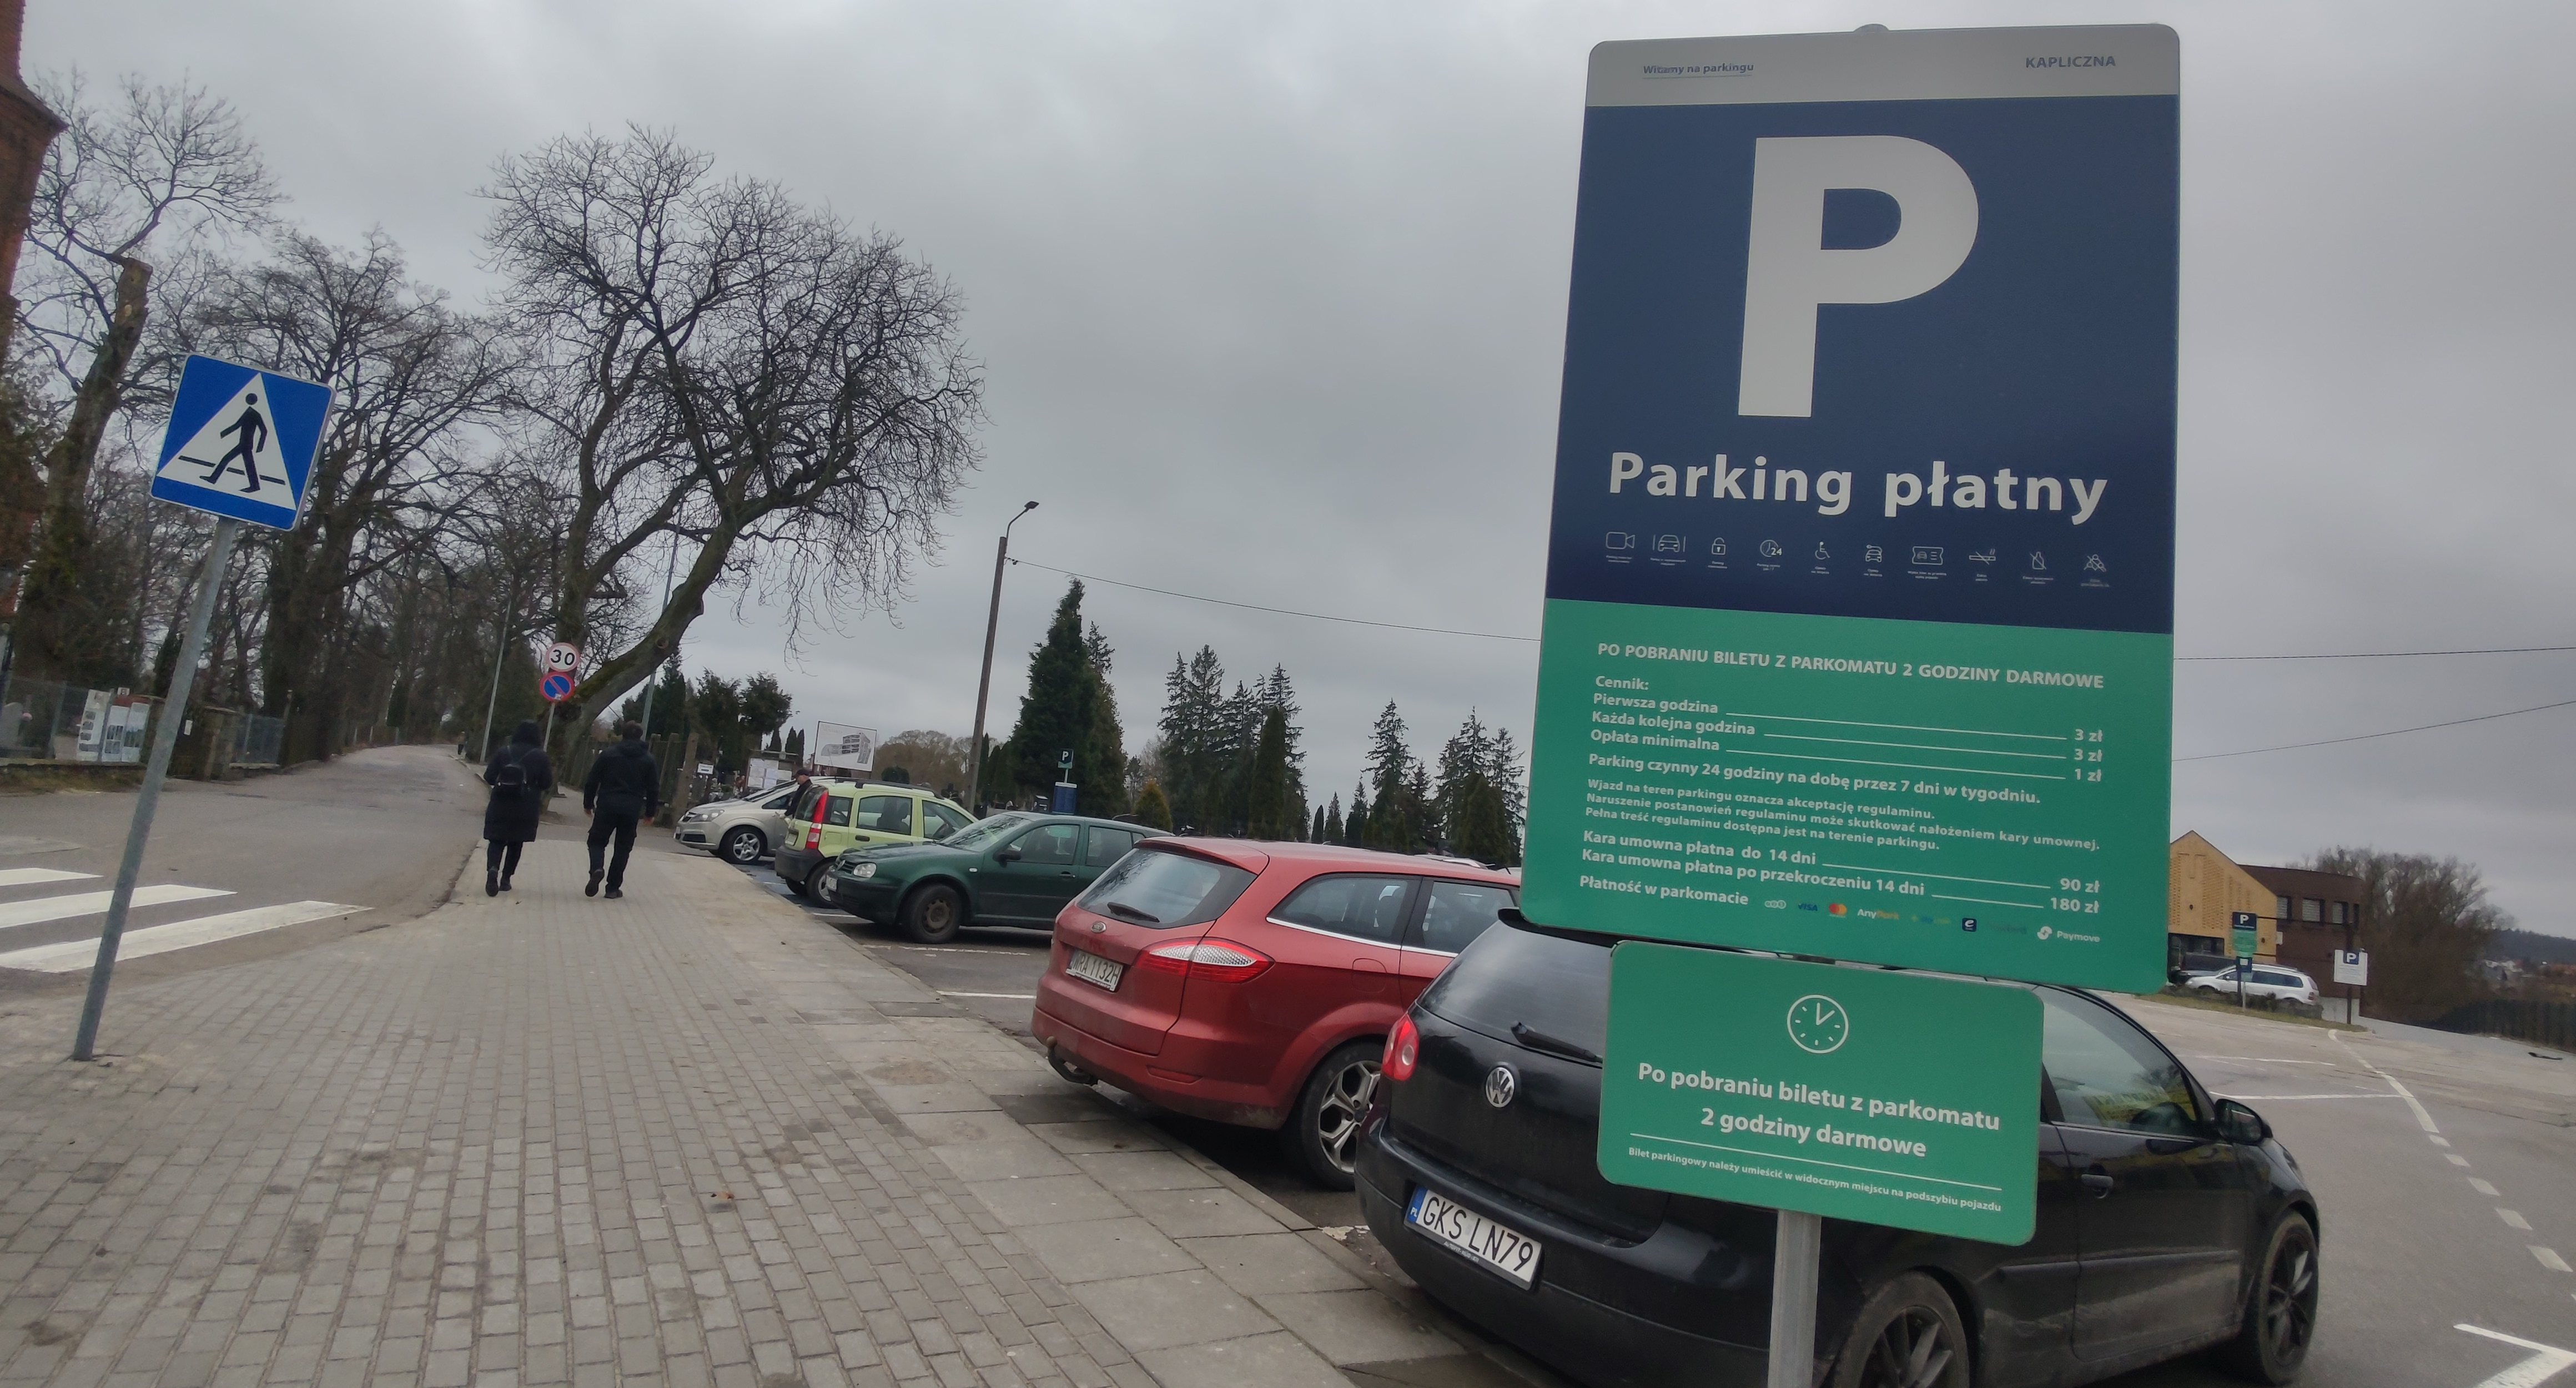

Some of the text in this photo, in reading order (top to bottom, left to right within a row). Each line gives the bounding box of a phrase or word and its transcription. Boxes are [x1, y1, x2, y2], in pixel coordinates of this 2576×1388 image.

[1643, 65, 1684, 74] Witamy
[1703, 63, 1754, 74] parkingu
[2026, 56, 2116, 68] KAPLICZNA
[1738, 135, 1979, 417] P
[1608, 452, 2108, 525] Parking płatny
[1771, 547, 1782, 556] 24
[550, 649, 575, 665] 30
[1598, 643, 2104, 688] PO POBRANIU BILETU Z PARKOMATU 2 GODZINY DARMOWE
[1596, 675, 1649, 690] Cennik:
[1593, 693, 1718, 713] Pierwsza godzina
[1592, 711, 1755, 735] Każda kolejna godzina
[1591, 729, 1719, 750] Opłata minimalna
[2074, 729, 2103, 742] 3 zł
[1062, 751, 1069, 761] P
[2074, 749, 2102, 762] 3 zł
[1589, 754, 2040, 803] Parking czynny 24 godziny na dobę przez 7 dni w tygodniu.
[2075, 769, 2102, 782] 1 zł
[1588, 779, 1623, 791] Wjazd
[1643, 785, 1674, 795] teren
[1677, 788, 1732, 802] parkingu
[1735, 795, 1783, 805] oznacza
[1787, 797, 1854, 814] akceptację
[1858, 805, 1935, 819] regulaminu.
[1586, 807, 1617, 819] Pełna
[1621, 811, 1649, 821] treść
[1652, 816, 1720, 828] regulaminu
[1723, 820, 1780, 835] dostępna
[1783, 826, 1807, 837] jest
[1828, 831, 1874, 843] terenie
[1877, 836, 1939, 851] parkingu.
[1587, 793, 2100, 851] Naruszenie postanowień regulaminu może skutkować nałożeniem kary umownej.
[1583, 830, 1815, 865] Kara umowna płatna do 14 dni
[1582, 849, 1924, 895] Kara umowna płatna po przekroczeniu 14 dni
[1580, 875, 1641, 893] Płatność
[1644, 885, 1657, 895] w
[1661, 886, 1748, 905] parkomacie
[2060, 878, 2100, 893] 90 zł
[1798, 903, 1818, 912] VISA
[2051, 897, 2099, 913] 180 zł
[2240, 914, 2249, 924] P
[2057, 930, 2100, 943] Paymove
[2346, 952, 2357, 963] P
[1090, 960, 1121, 986] 1132H
[1639, 1062, 2000, 1130] Po pobraniu biletu z parkomatu
[1701, 1108, 1926, 1157] 2 godziny darmowe
[1629, 1147, 1649, 1158] Bilet
[1651, 1153, 1707, 1168] parkingowy
[1709, 1161, 1740, 1173] należy
[1742, 1167, 1783, 1179] umieścić
[1795, 1174, 1849, 1189] widocznym
[1852, 1183, 1889, 1195] miejscu
[1906, 1192, 1958, 1205] podszybiu
[1960, 1200, 2001, 1212] pojazdu
[1410, 1207, 1418, 1218] PL
[1423, 1197, 1467, 1239] GKS
[1468, 1218, 1533, 1272] LN79
